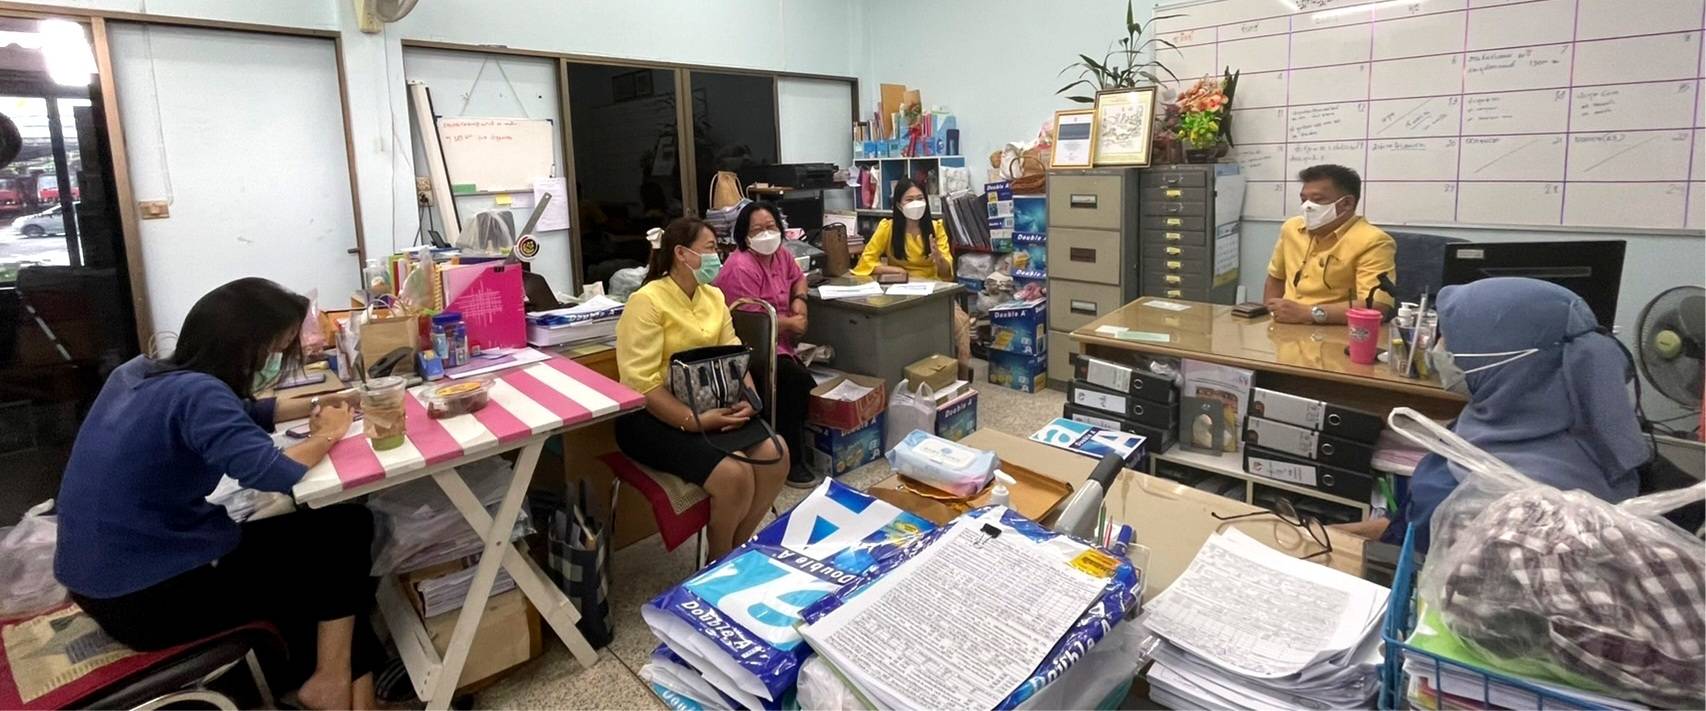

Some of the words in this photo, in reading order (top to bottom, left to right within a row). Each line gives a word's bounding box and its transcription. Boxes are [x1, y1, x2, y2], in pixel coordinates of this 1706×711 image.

[1017, 233, 1042, 241] Double
[1015, 269, 1040, 277] Double
[994, 311, 1019, 319] Double
[944, 402, 967, 418] Double
[776, 549, 796, 560] A
[794, 555, 858, 584] Double
[680, 599, 735, 638] Double
